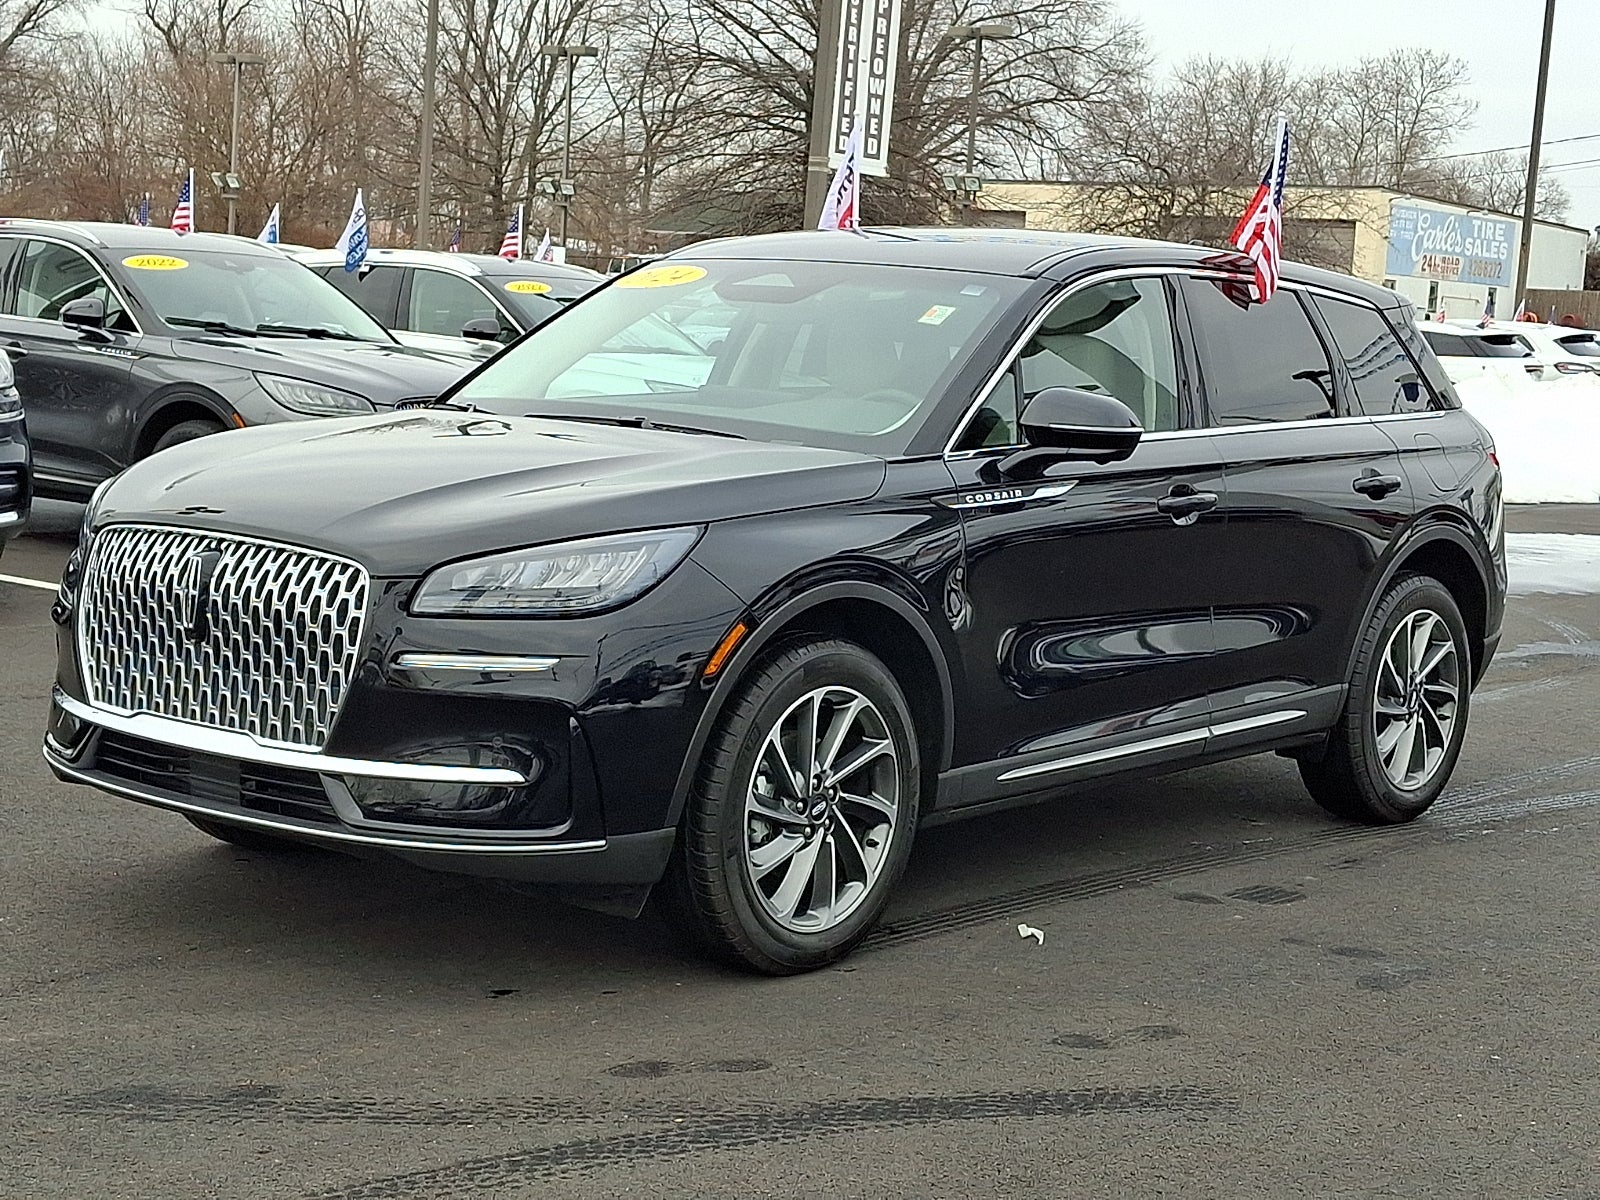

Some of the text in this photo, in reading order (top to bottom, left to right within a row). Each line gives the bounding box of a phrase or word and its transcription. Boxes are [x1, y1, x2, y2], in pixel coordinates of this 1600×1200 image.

[867, 0, 889, 155] PREOWNED
[1411, 212, 1464, 262] Earle's
[1472, 219, 1506, 241] TIRE
[1464, 238, 1508, 260] SALES
[136, 259, 177, 267] 2022
[965, 489, 1023, 503] CORSAIR
